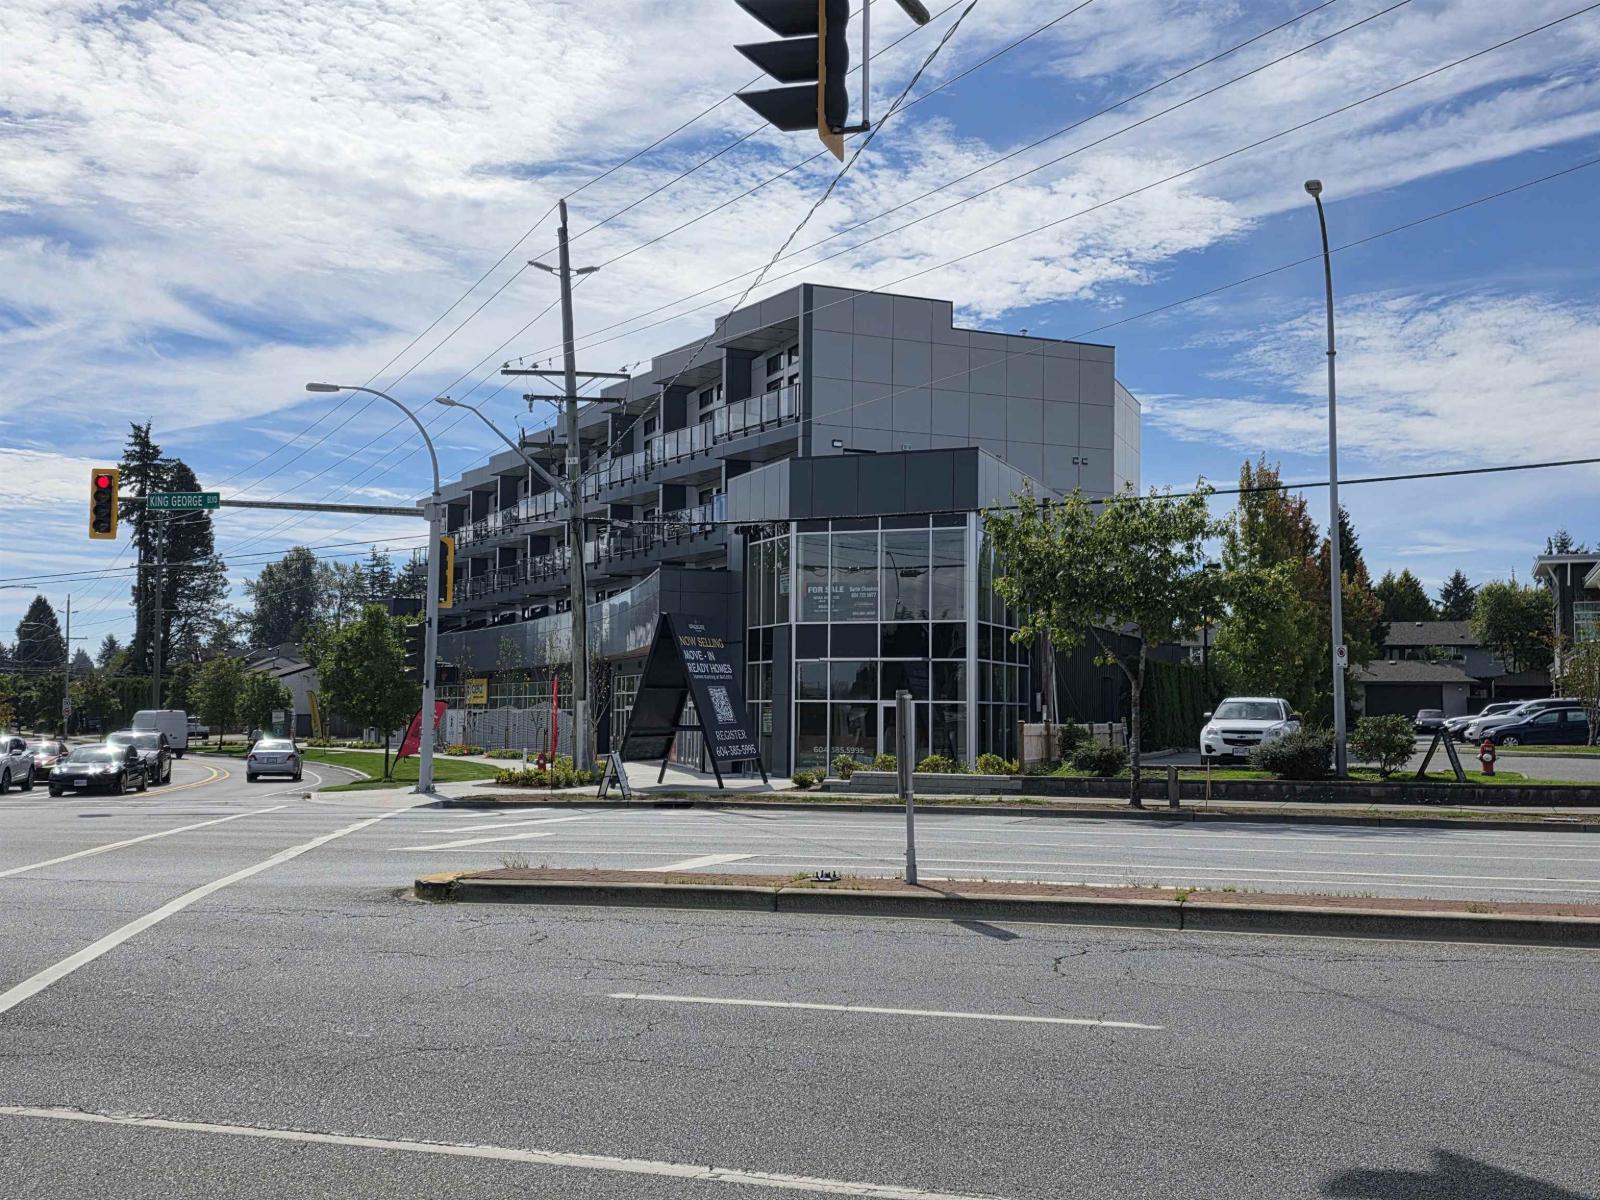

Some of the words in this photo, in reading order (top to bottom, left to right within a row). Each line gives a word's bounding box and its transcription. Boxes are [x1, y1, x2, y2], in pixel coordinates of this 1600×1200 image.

[150, 496, 169, 506] KING
[171, 495, 202, 506] GEORGE
[808, 586, 824, 594] FOR
[679, 635, 696, 646] NOW
[697, 637, 725, 648] SELLING
[683, 650, 704, 660] MOVE
[706, 651, 716, 661] IN
[687, 663, 709, 673] READY
[709, 664, 732, 673] HOMES
[715, 729, 747, 740] REGISTER
[716, 744, 756, 756] 604-385-5995
[813, 746, 865, 754] 604385.5995
